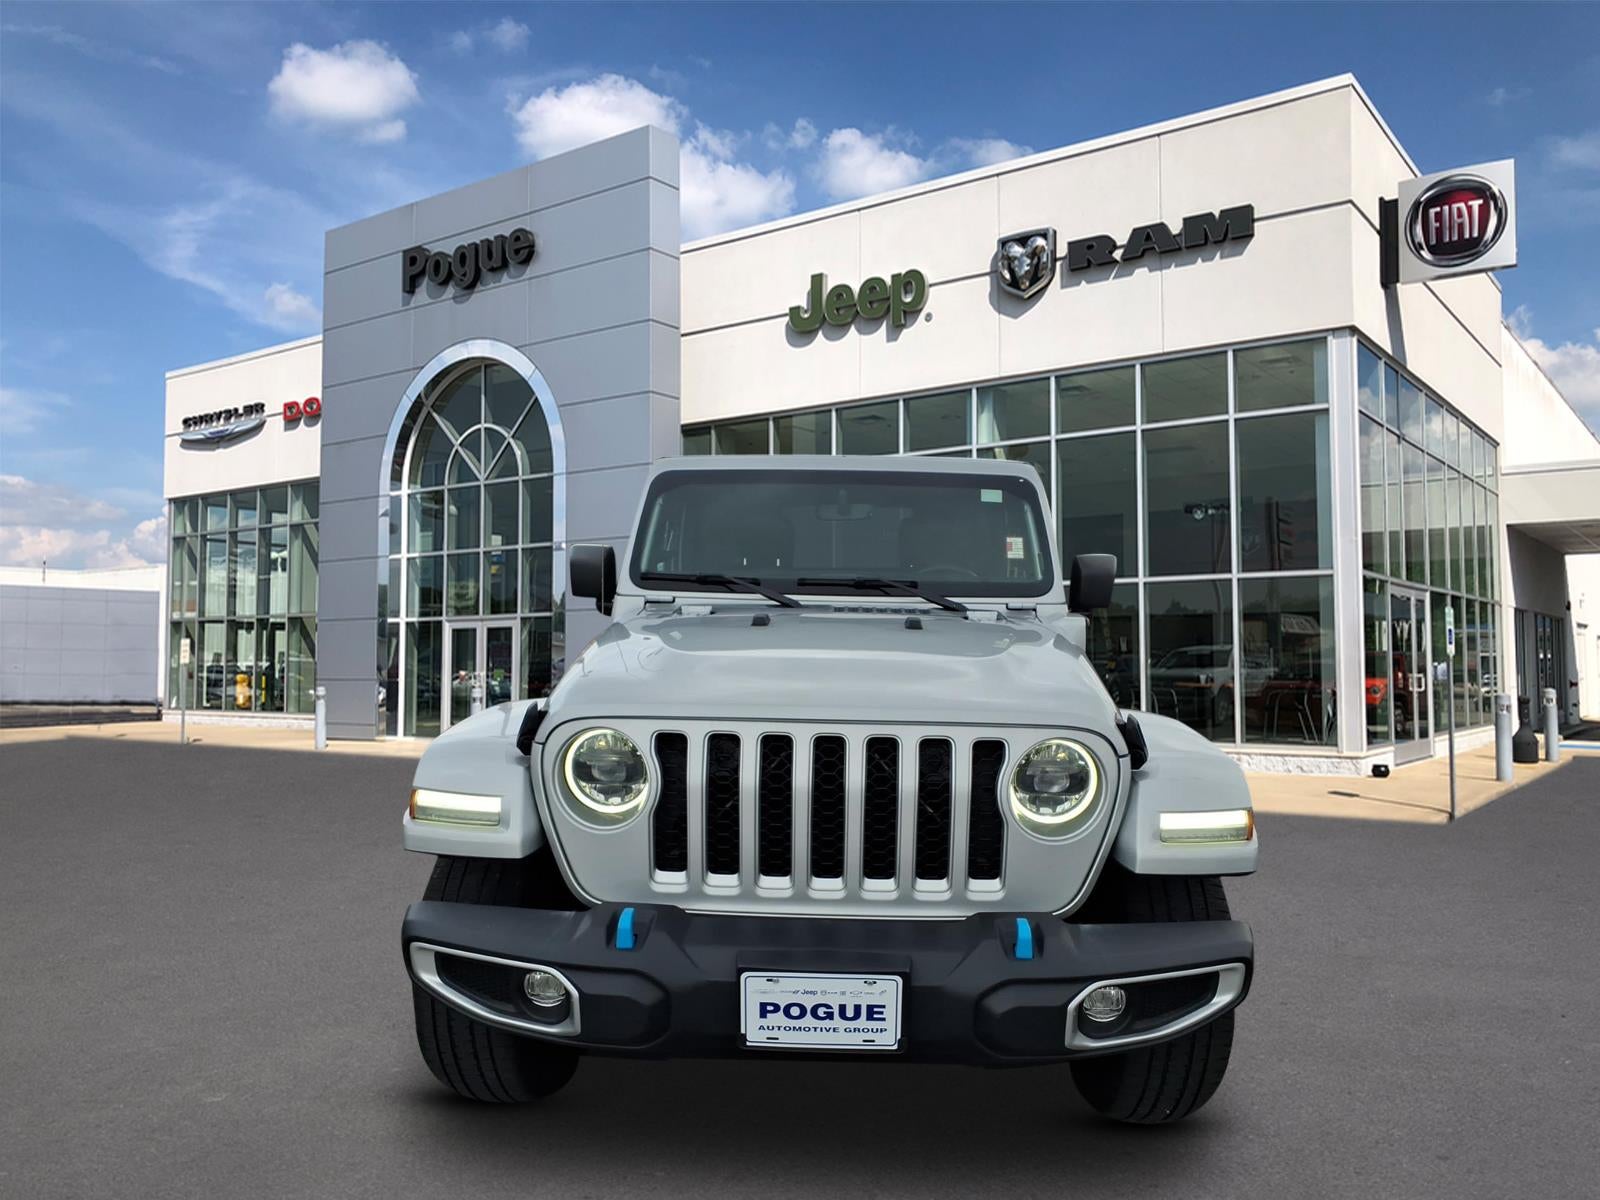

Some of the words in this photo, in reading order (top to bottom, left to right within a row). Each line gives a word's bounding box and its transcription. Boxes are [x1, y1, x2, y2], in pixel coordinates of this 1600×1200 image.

[1066, 204, 1254, 271] RAM
[1428, 199, 1484, 246] FIAT
[402, 227, 535, 294] Pogue
[788, 268, 929, 333] Jeep
[182, 402, 265, 429] CHRYSLER
[758, 1024, 840, 1033] AUTOMOTIVE
[844, 1025, 888, 1034] GROUP
[759, 1001, 886, 1021] POGUE
